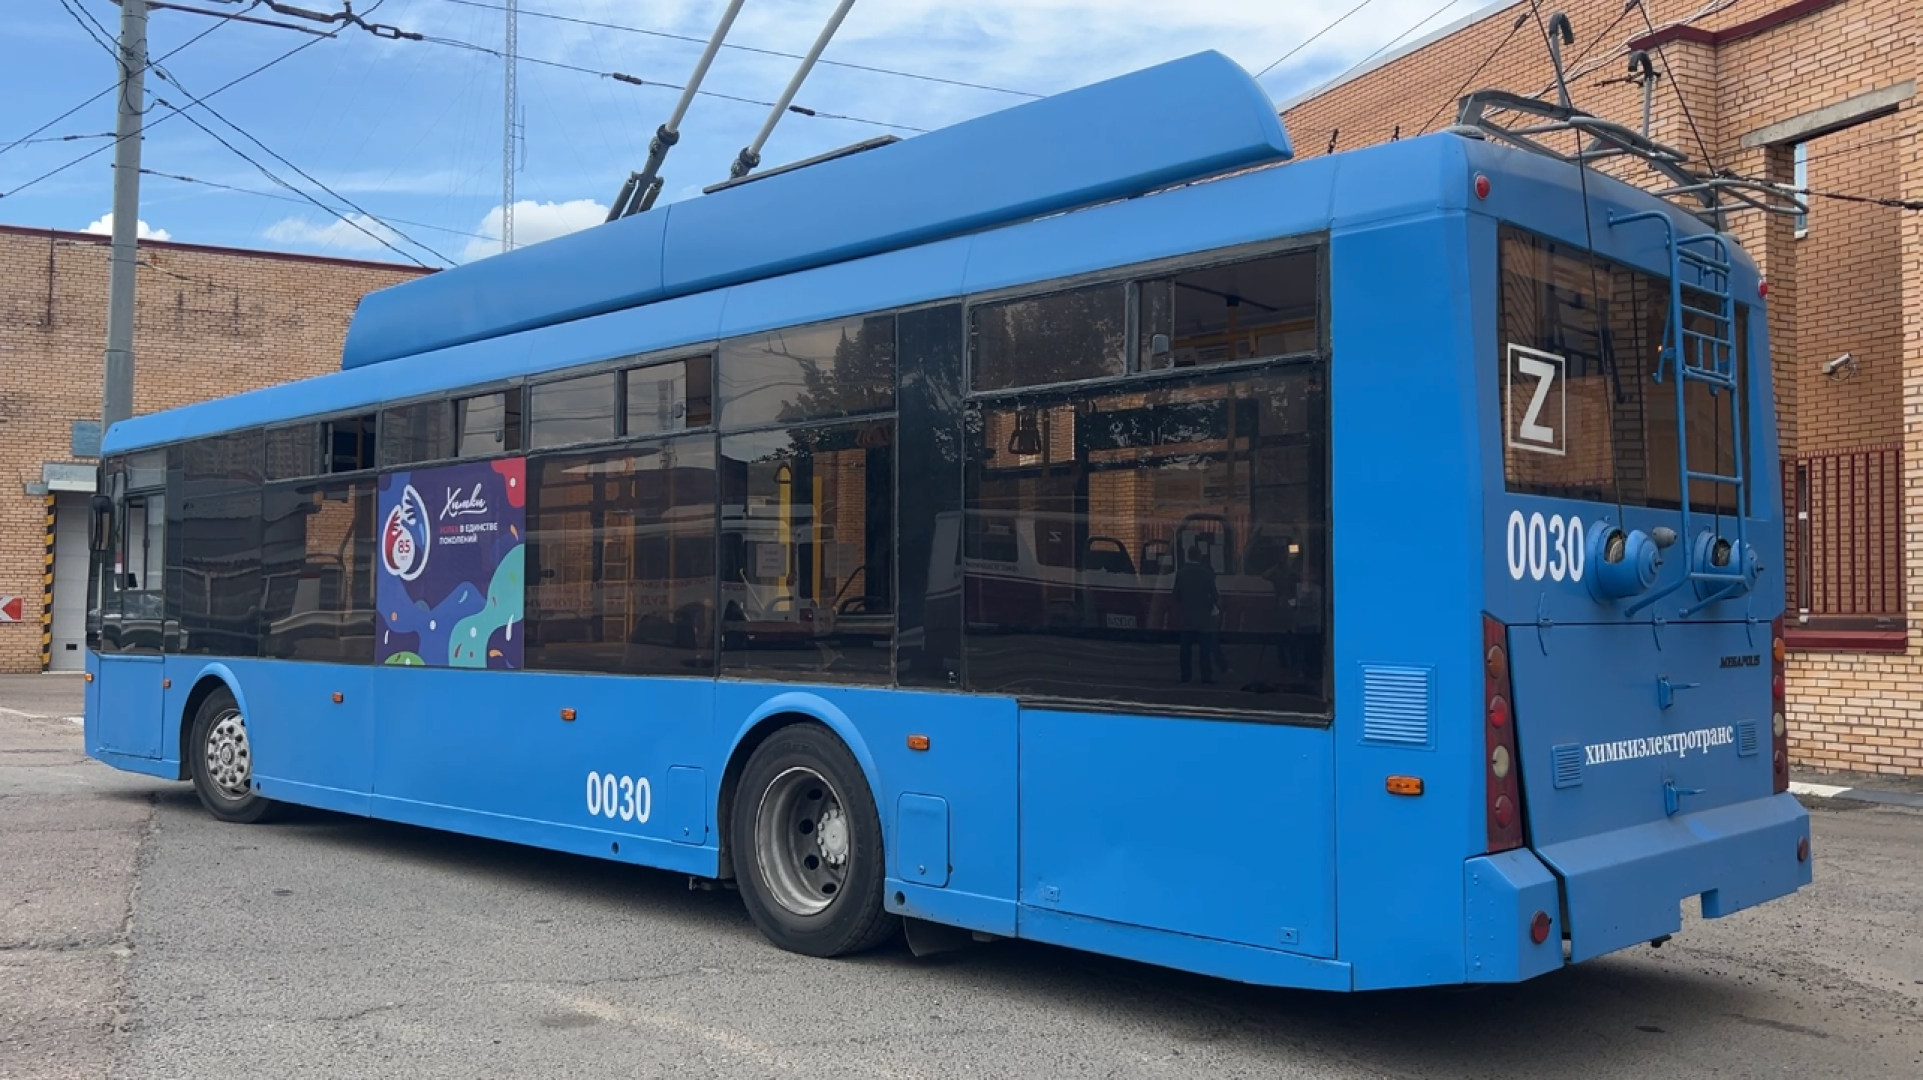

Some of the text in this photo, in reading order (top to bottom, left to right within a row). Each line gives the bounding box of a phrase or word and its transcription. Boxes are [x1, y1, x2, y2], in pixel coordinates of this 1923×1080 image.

[1519, 356, 1556, 443] Z
[440, 483, 488, 521] Химки
[398, 539, 410, 553] 85
[1507, 510, 1585, 582] 0030
[1584, 725, 1734, 765] химкиэлектротранс
[586, 770, 651, 824] 0030
